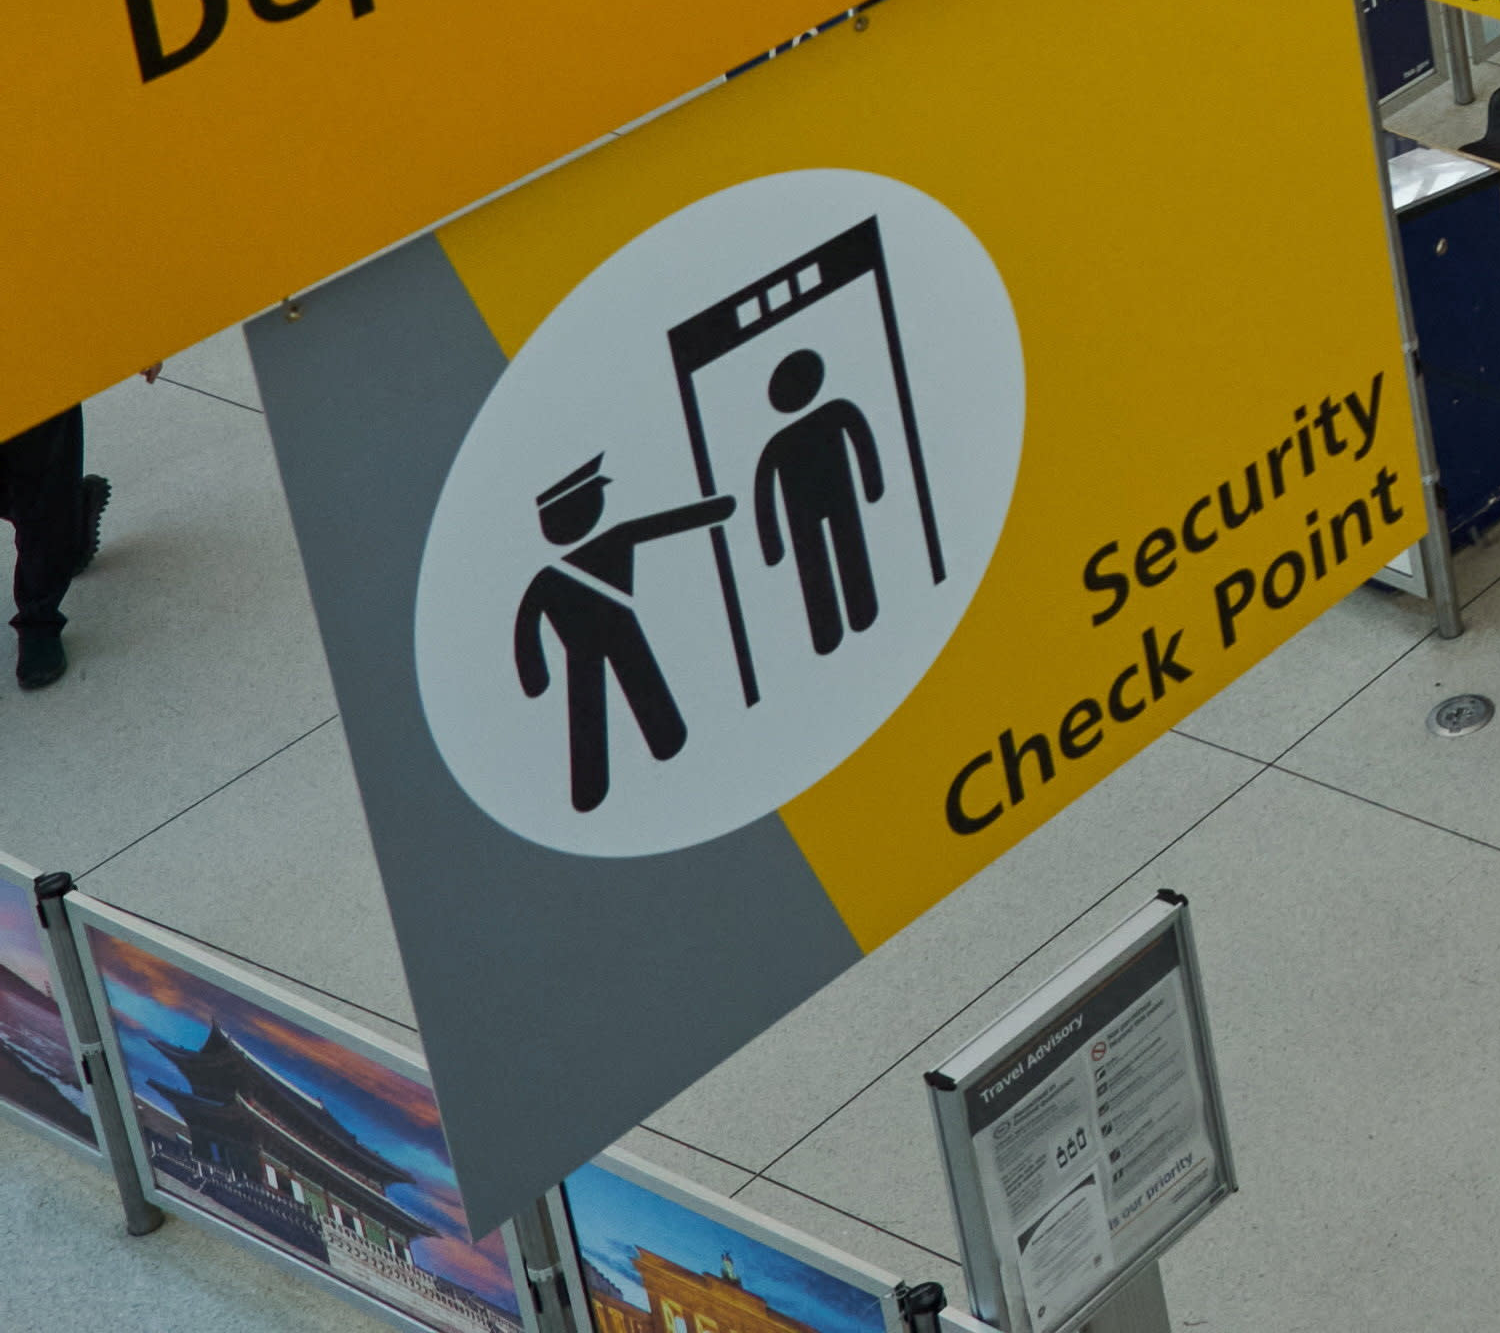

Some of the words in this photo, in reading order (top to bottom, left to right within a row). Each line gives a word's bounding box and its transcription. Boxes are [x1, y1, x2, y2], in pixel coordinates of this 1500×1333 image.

[1080, 370, 1386, 628] Security
[944, 626, 1195, 837] Check
[1211, 465, 1405, 650] Point
[978, 1063, 1025, 1105] Travel
[1025, 1012, 1086, 1071] Advisory
[1120, 1196, 1144, 1220] our
[1144, 1151, 1195, 1202] priority
